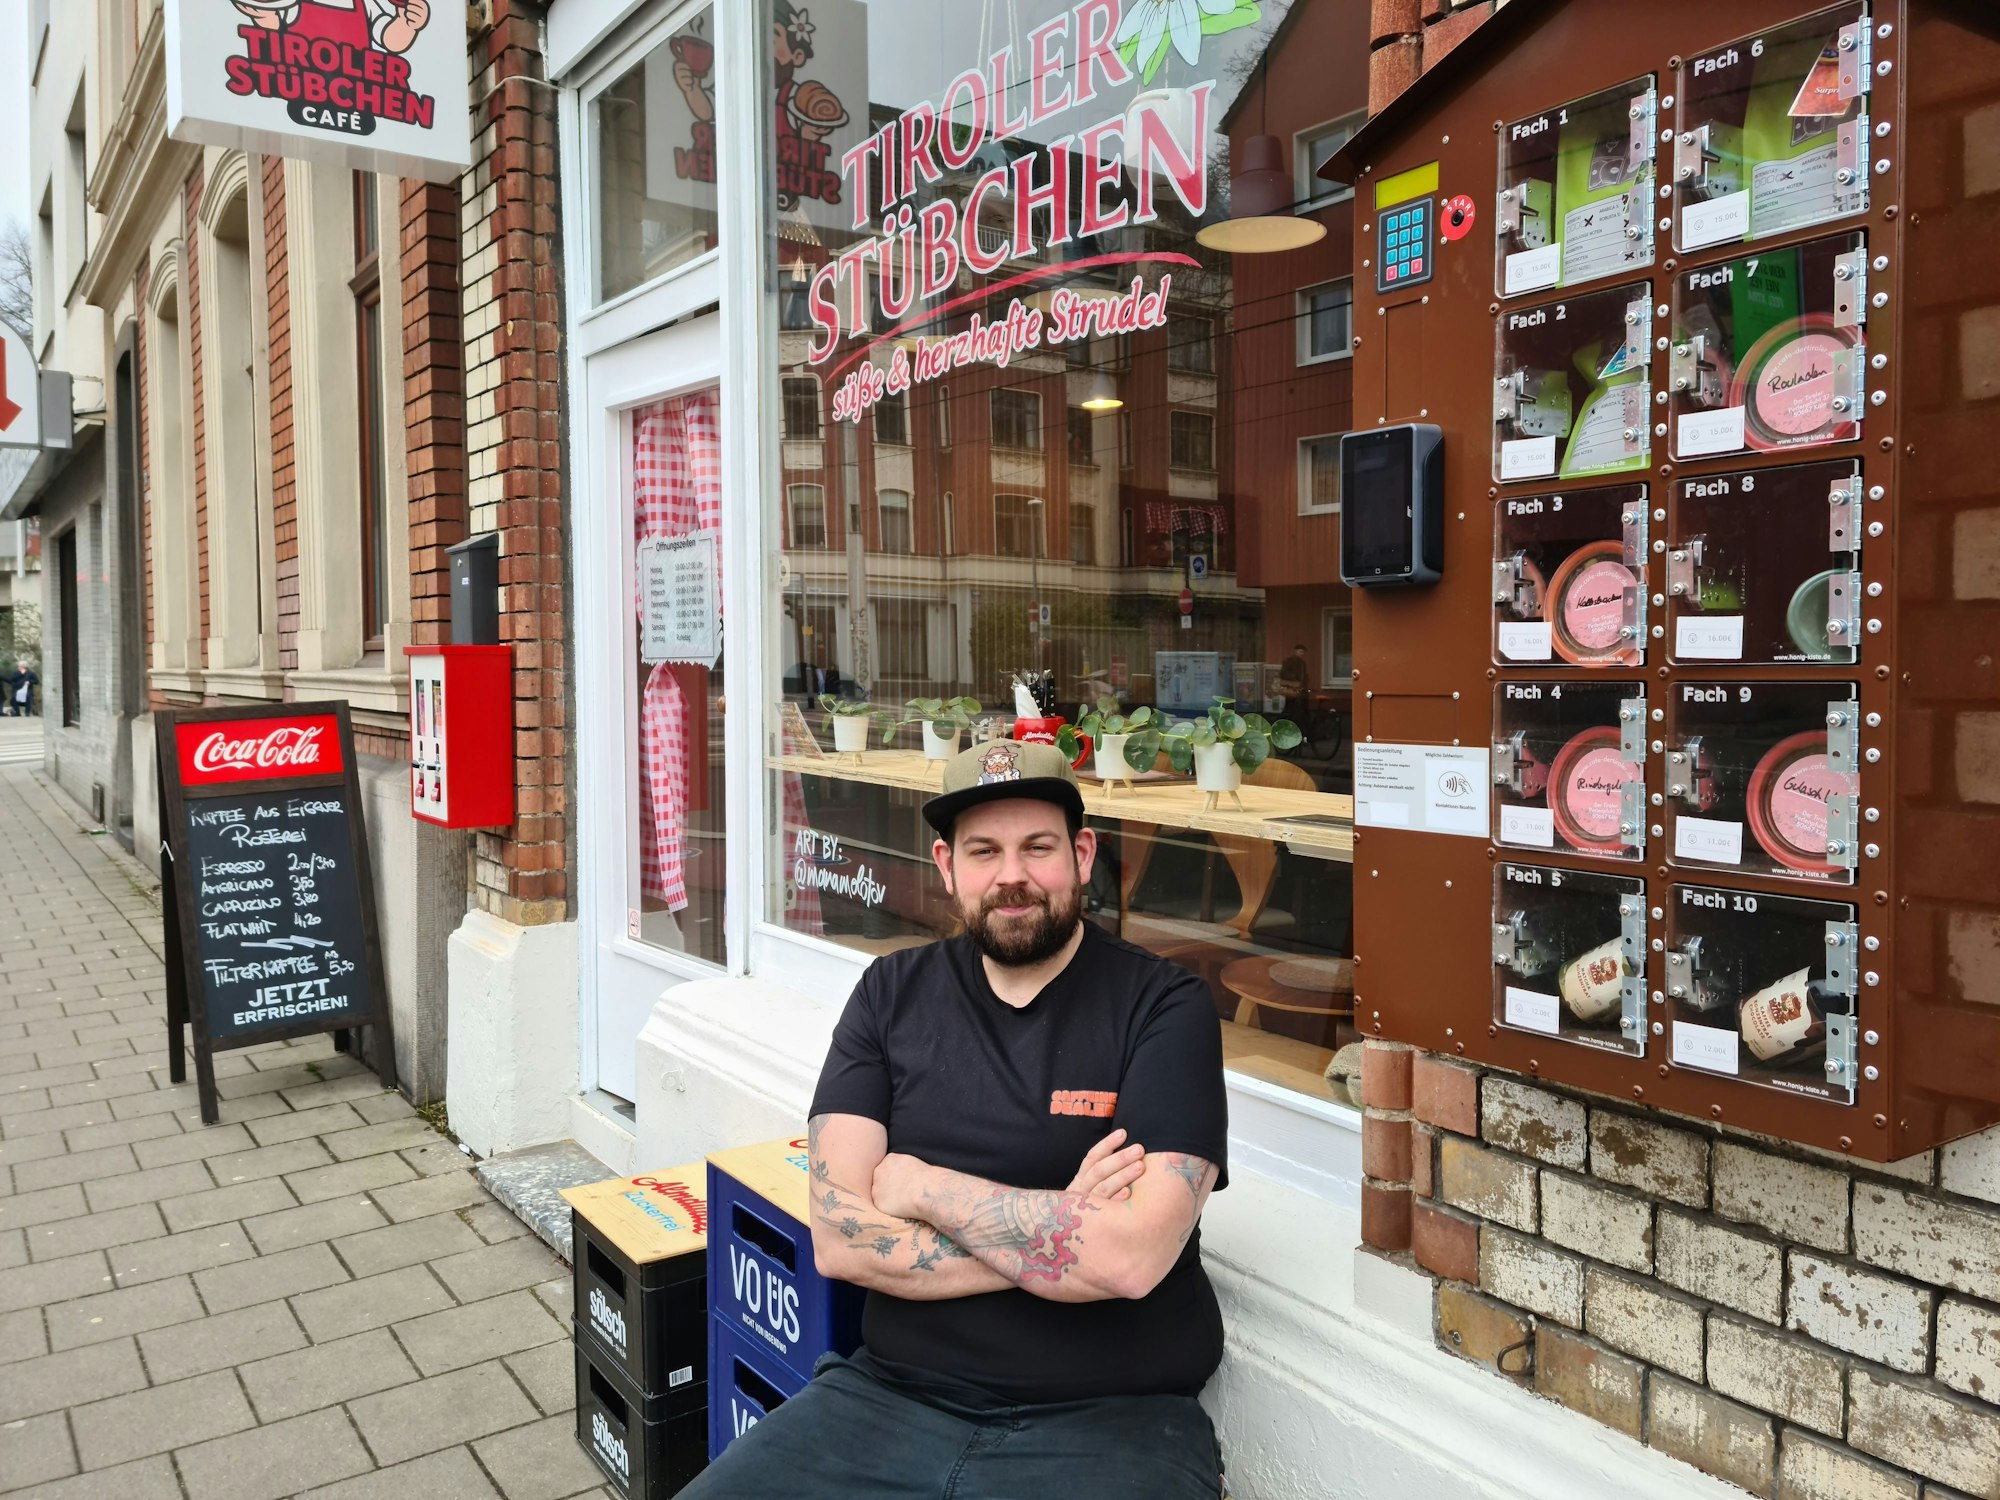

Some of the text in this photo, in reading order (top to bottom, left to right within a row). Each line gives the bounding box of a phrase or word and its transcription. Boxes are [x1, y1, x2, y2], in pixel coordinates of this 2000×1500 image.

[238, 26, 411, 89] TIROLER
[1693, 39, 1764, 77] Fach 6
[226, 57, 435, 128] STÜBCHEN
[1814, 86, 1840, 95] Surpri
[302, 106, 362, 131] CAFÉ
[842, 0, 1133, 230] TIROLER
[1512, 109, 1569, 141] Fach 1
[1446, 198, 1475, 218] START
[1714, 212, 1739, 224] 15.00€
[808, 80, 1216, 365] STÜBCHEN
[1689, 267, 1733, 291] Fach
[1746, 259, 1759, 278] 7
[1509, 304, 1567, 331] Fach 2
[832, 274, 1171, 424] süße & herzhafte Strudel
[1768, 363, 1828, 393] Rouladen
[1709, 426, 1734, 436] 15.00€
[1776, 433, 1835, 446] www.honig-kiste.de
[1685, 476, 1755, 499] Fach 8
[1508, 496, 1563, 516] Fach 3
[655, 538, 697, 552] Öffnungszeiten
[1708, 634, 1732, 642] 16.00€
[1773, 653, 1831, 662] www.honig-kiste.de
[1506, 685, 1562, 700] Fach 4
[1683, 687, 1752, 703] Fach 9
[194, 726, 324, 772] Coca-Cola
[1783, 776, 1822, 800] Gulasch
[190, 803, 247, 827] KAFFEE
[795, 829, 842, 861] ART BY:
[201, 855, 266, 878] ESPRESSO
[1506, 866, 1562, 887] Fach 5
[1771, 867, 1829, 879] www.honig-kiste.de
[1682, 889, 1758, 913] Fach 10
[294, 912, 322, 929] 4,20
[248, 978, 330, 1007] JETZT
[233, 995, 349, 1026] ERFRISCHEN!
[1578, 1035, 1624, 1050] www.honig-kiste.de
[1771, 1078, 1830, 1097] www.honig-kiste.de
[623, 1191, 687, 1232] Zuckerfrei
[590, 1288, 627, 1348] sölsch
[592, 1412, 629, 1477] sölsch
